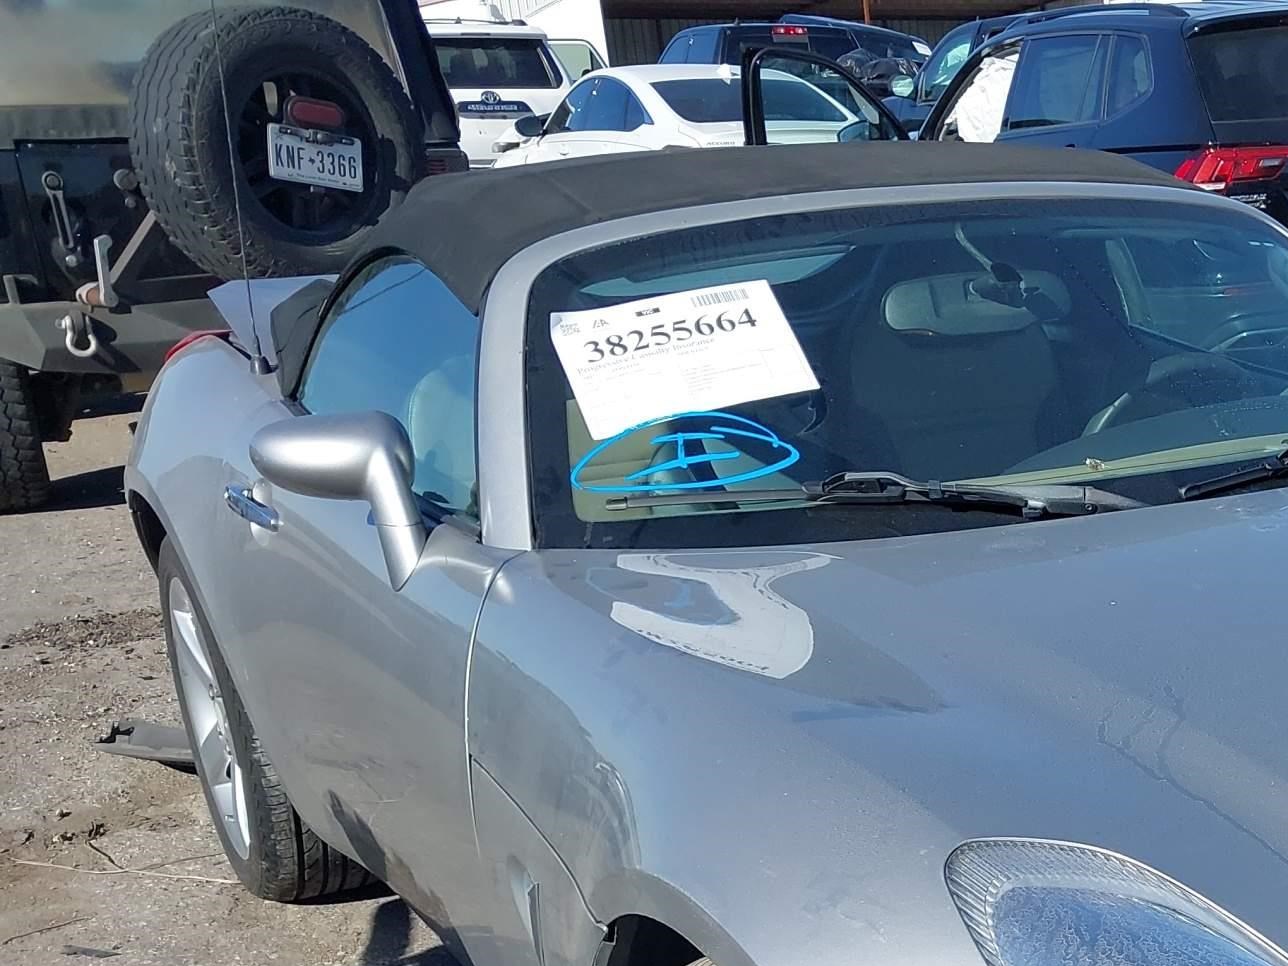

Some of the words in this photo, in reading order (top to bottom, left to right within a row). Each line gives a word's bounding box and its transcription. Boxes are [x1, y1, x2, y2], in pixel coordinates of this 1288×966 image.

[275, 143, 305, 170] KNF
[316, 150, 357, 179] 3366
[584, 307, 757, 363] 38255664
